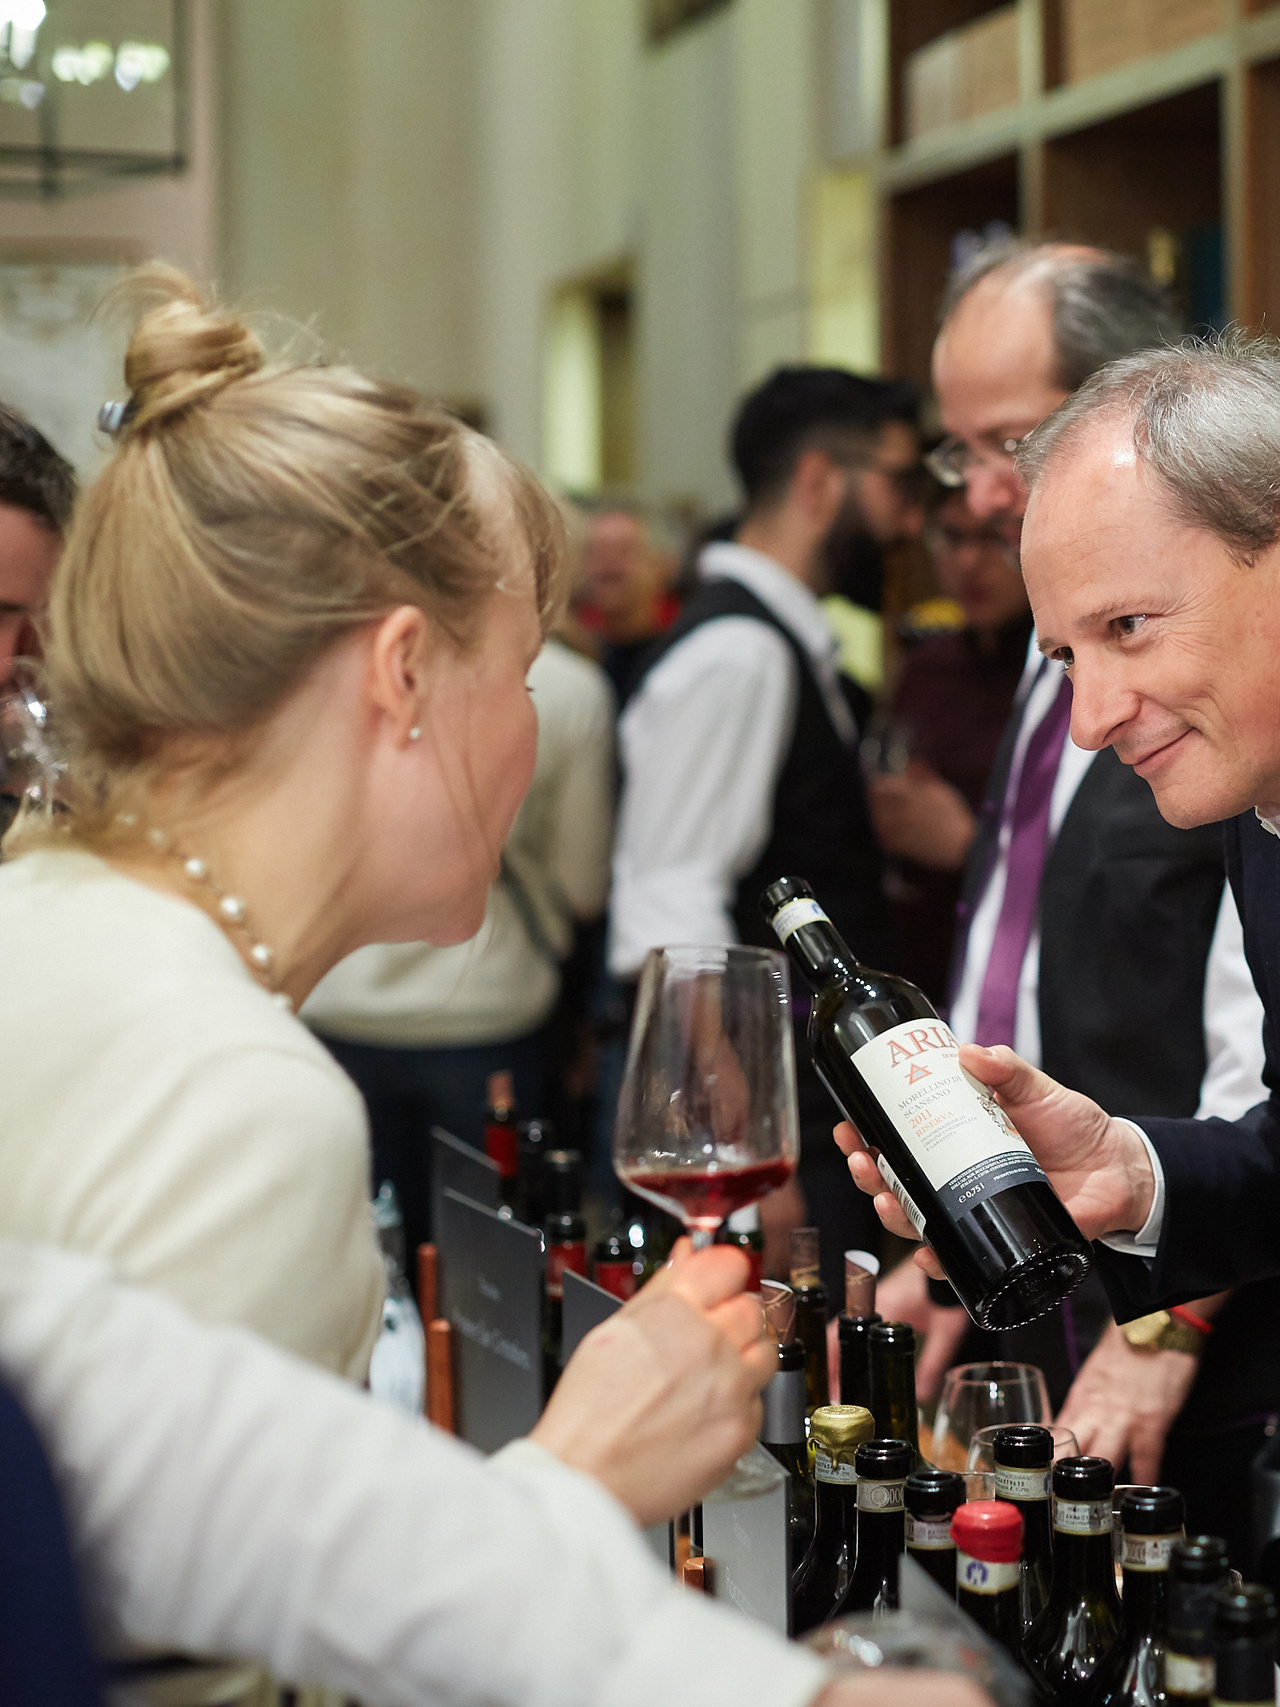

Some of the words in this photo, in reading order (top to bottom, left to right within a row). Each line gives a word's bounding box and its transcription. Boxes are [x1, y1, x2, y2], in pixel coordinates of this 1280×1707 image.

[898, 1079, 951, 1111] MORELLINO
[903, 1089, 951, 1119] SCANSANO
[909, 1109, 932, 1129] 2011
[915, 1111, 955, 1137] RISERVA
[920, 1118, 959, 1143] DENOMINAZIONE
[923, 1132, 943, 1147] ORIGINE
[965, 1186, 981, 1198] 0,75
